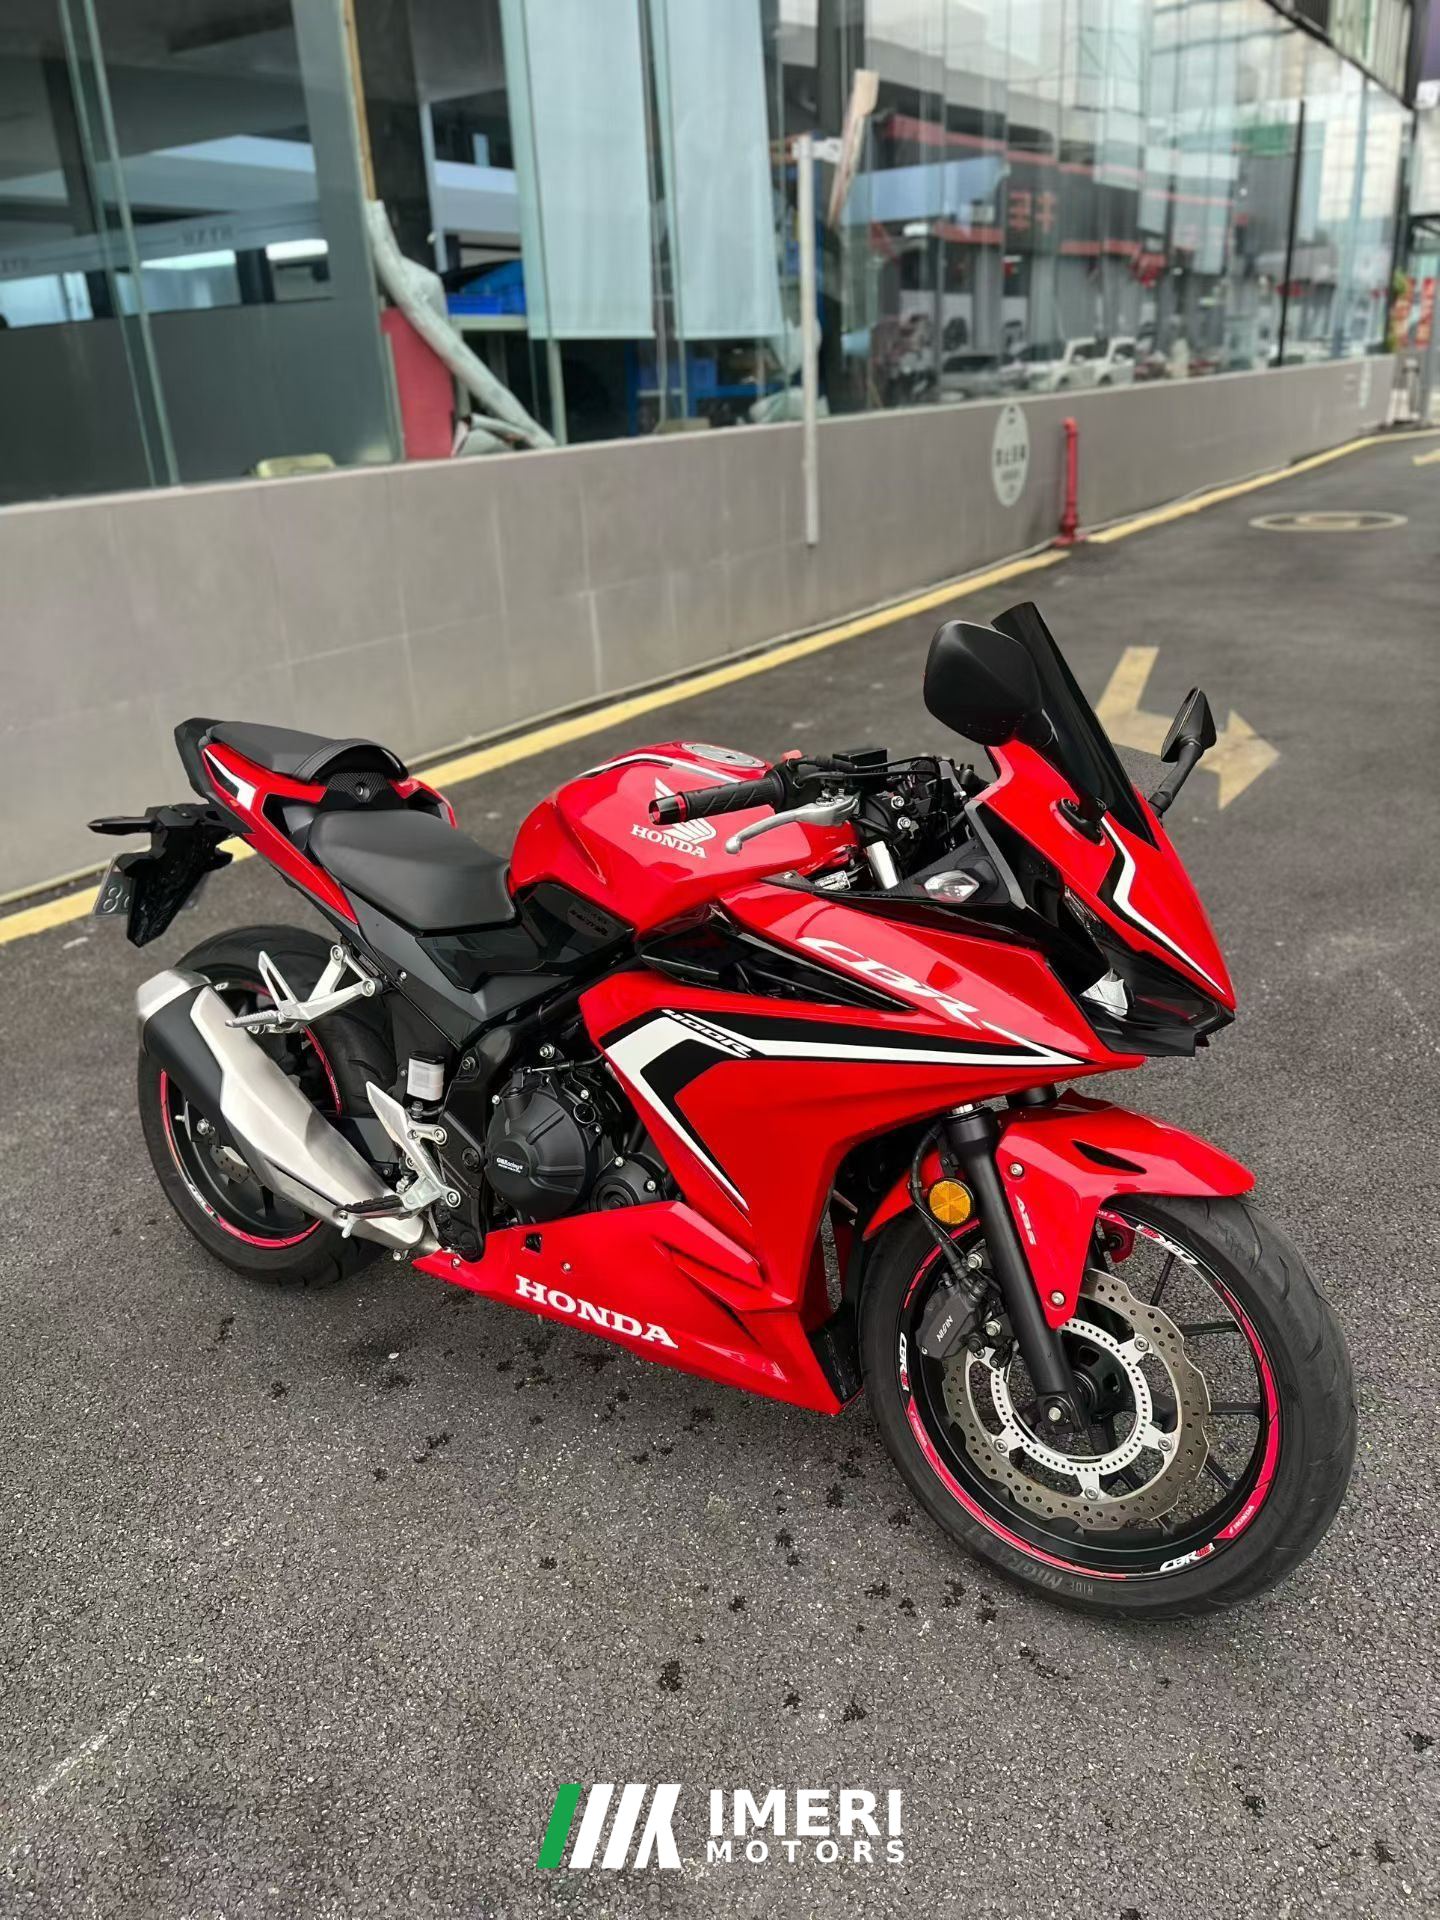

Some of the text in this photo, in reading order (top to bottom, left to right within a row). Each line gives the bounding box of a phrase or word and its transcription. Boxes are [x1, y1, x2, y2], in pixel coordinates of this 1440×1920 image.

[630, 824, 707, 858] HONDA
[796, 937, 982, 1030] CBR
[661, 1009, 751, 1058] 400R
[515, 1274, 679, 1349] HONDA
